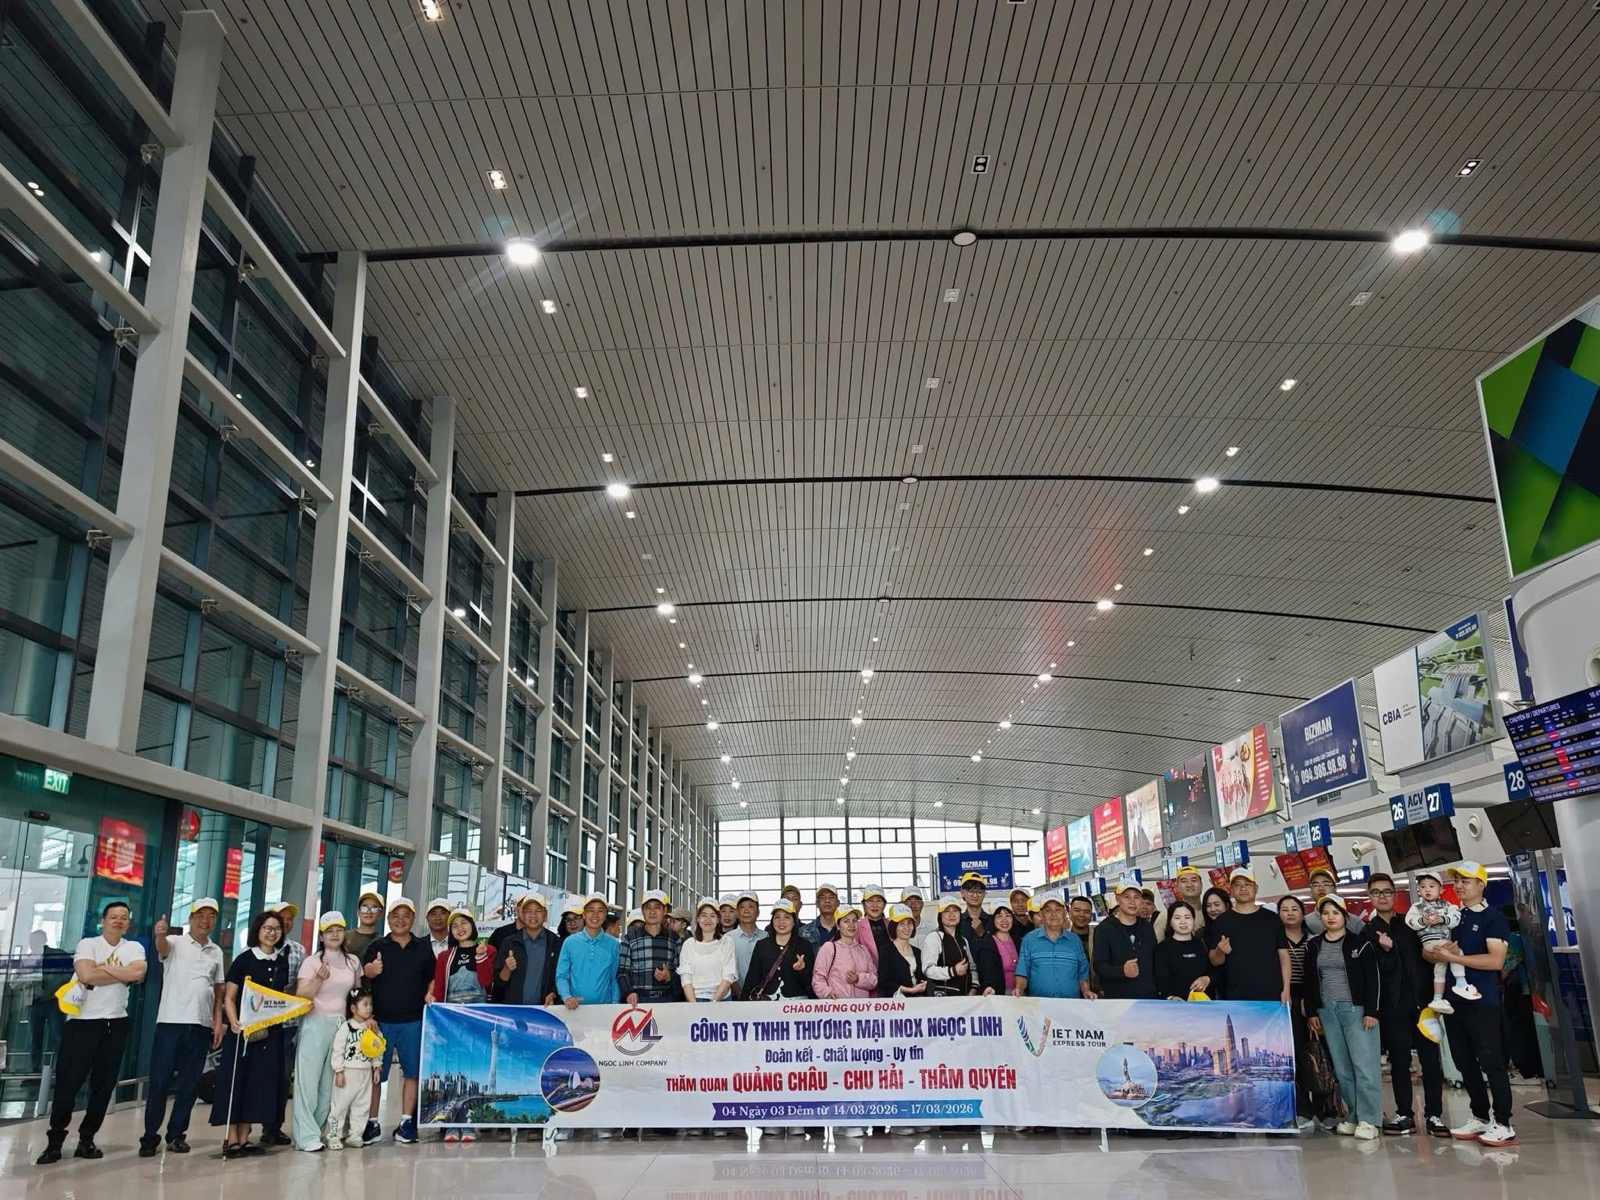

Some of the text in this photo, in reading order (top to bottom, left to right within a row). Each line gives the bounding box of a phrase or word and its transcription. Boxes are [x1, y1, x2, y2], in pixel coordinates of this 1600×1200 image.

[1382, 708, 1401, 725] CBIA
[1532, 703, 1560, 717] DEPARTURES
[1304, 716, 1332, 741] BIZMAN
[1301, 754, 1347, 784] 094.986.98.98
[45, 769, 68, 793] EXIT
[1508, 770, 1525, 791] 28
[1408, 792, 1423, 808] ACV
[1427, 792, 1439, 812] 27
[1392, 802, 1404, 821] 26
[1285, 832, 1295, 848] 24
[1311, 825, 1321, 842] 25
[961, 860, 988, 869] BIZMAN
[782, 1001, 905, 1014] CHÀO MỪNG QUÝ ĐOÀN
[690, 1016, 1003, 1042] CÔNG TY TNHH THƯƠNG MẠI INOX NGỌC LINH
[1076, 1029, 1105, 1040] NAM
[1088, 1040, 1107, 1048] TOUR
[765, 1048, 793, 1063] Đoàn
[795, 1045, 814, 1063] kết
[823, 1045, 848, 1062] Chất
[851, 1047, 884, 1064] lượng
[893, 1046, 907, 1063] Uy
[908, 1045, 924, 1060] tín
[666, 1073, 697, 1092] THĂM
[699, 1077, 728, 1093] QUAN
[732, 1065, 783, 1093] QUẢNG
[787, 1066, 828, 1091] CHÂU
[843, 1070, 874, 1090] CHU
[878, 1062, 904, 1090] HẢI
[919, 1063, 964, 1089] THÂM
[968, 1064, 1016, 1090] QUYẾN
[722, 1106, 737, 1116] 04
[739, 1105, 768, 1119] Ngày
[770, 1105, 785, 1116] 03
[787, 1104, 814, 1116] Đêm
[817, 1104, 829, 1116] từ
[834, 1103, 898, 1116] 14/03/2026
[911, 1103, 974, 1115] 17/03/2026
